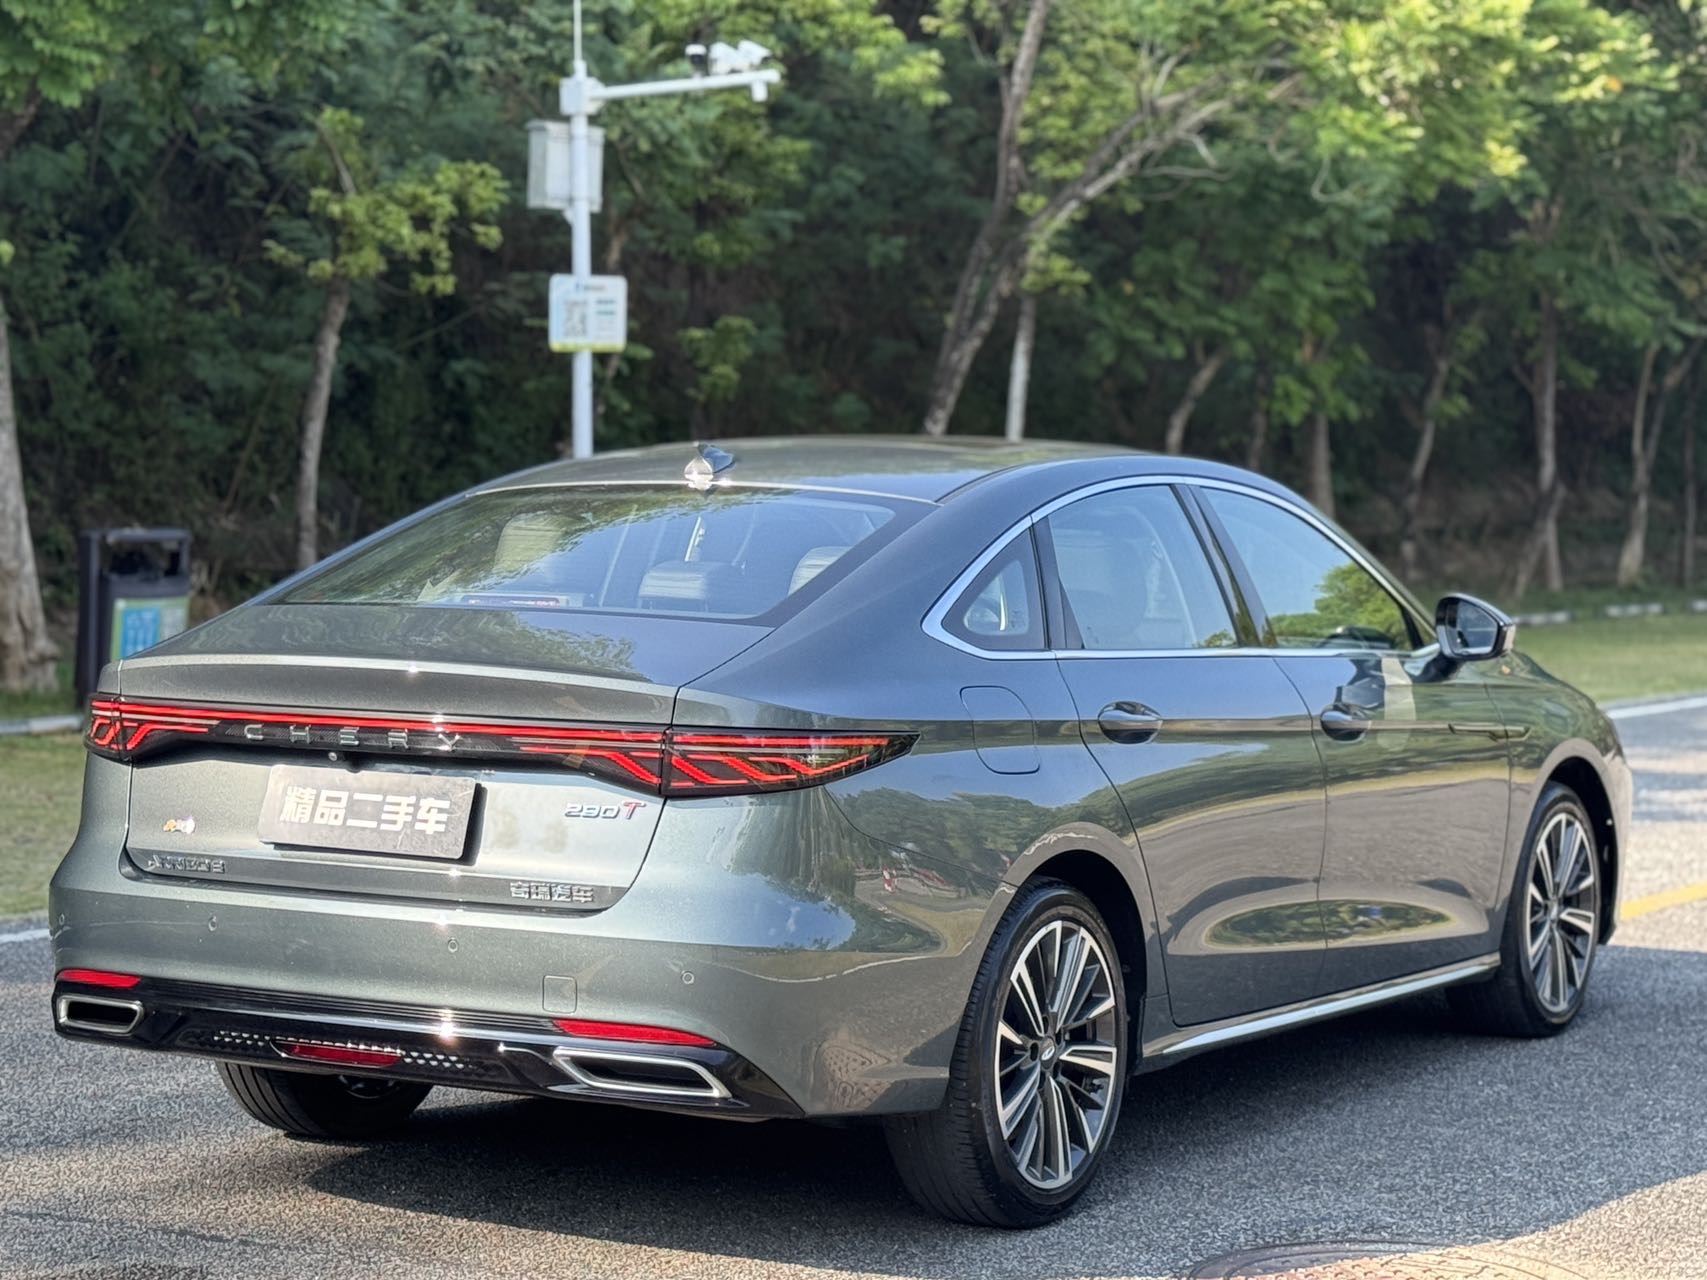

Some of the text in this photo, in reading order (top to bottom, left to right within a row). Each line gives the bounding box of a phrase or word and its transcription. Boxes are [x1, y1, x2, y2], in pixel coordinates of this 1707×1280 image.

[244, 723, 462, 751] CHERY
[279, 785, 452, 835] 精品二手车
[564, 800, 647, 820] 290T
[509, 881, 595, 903] 奇瑞汽车
